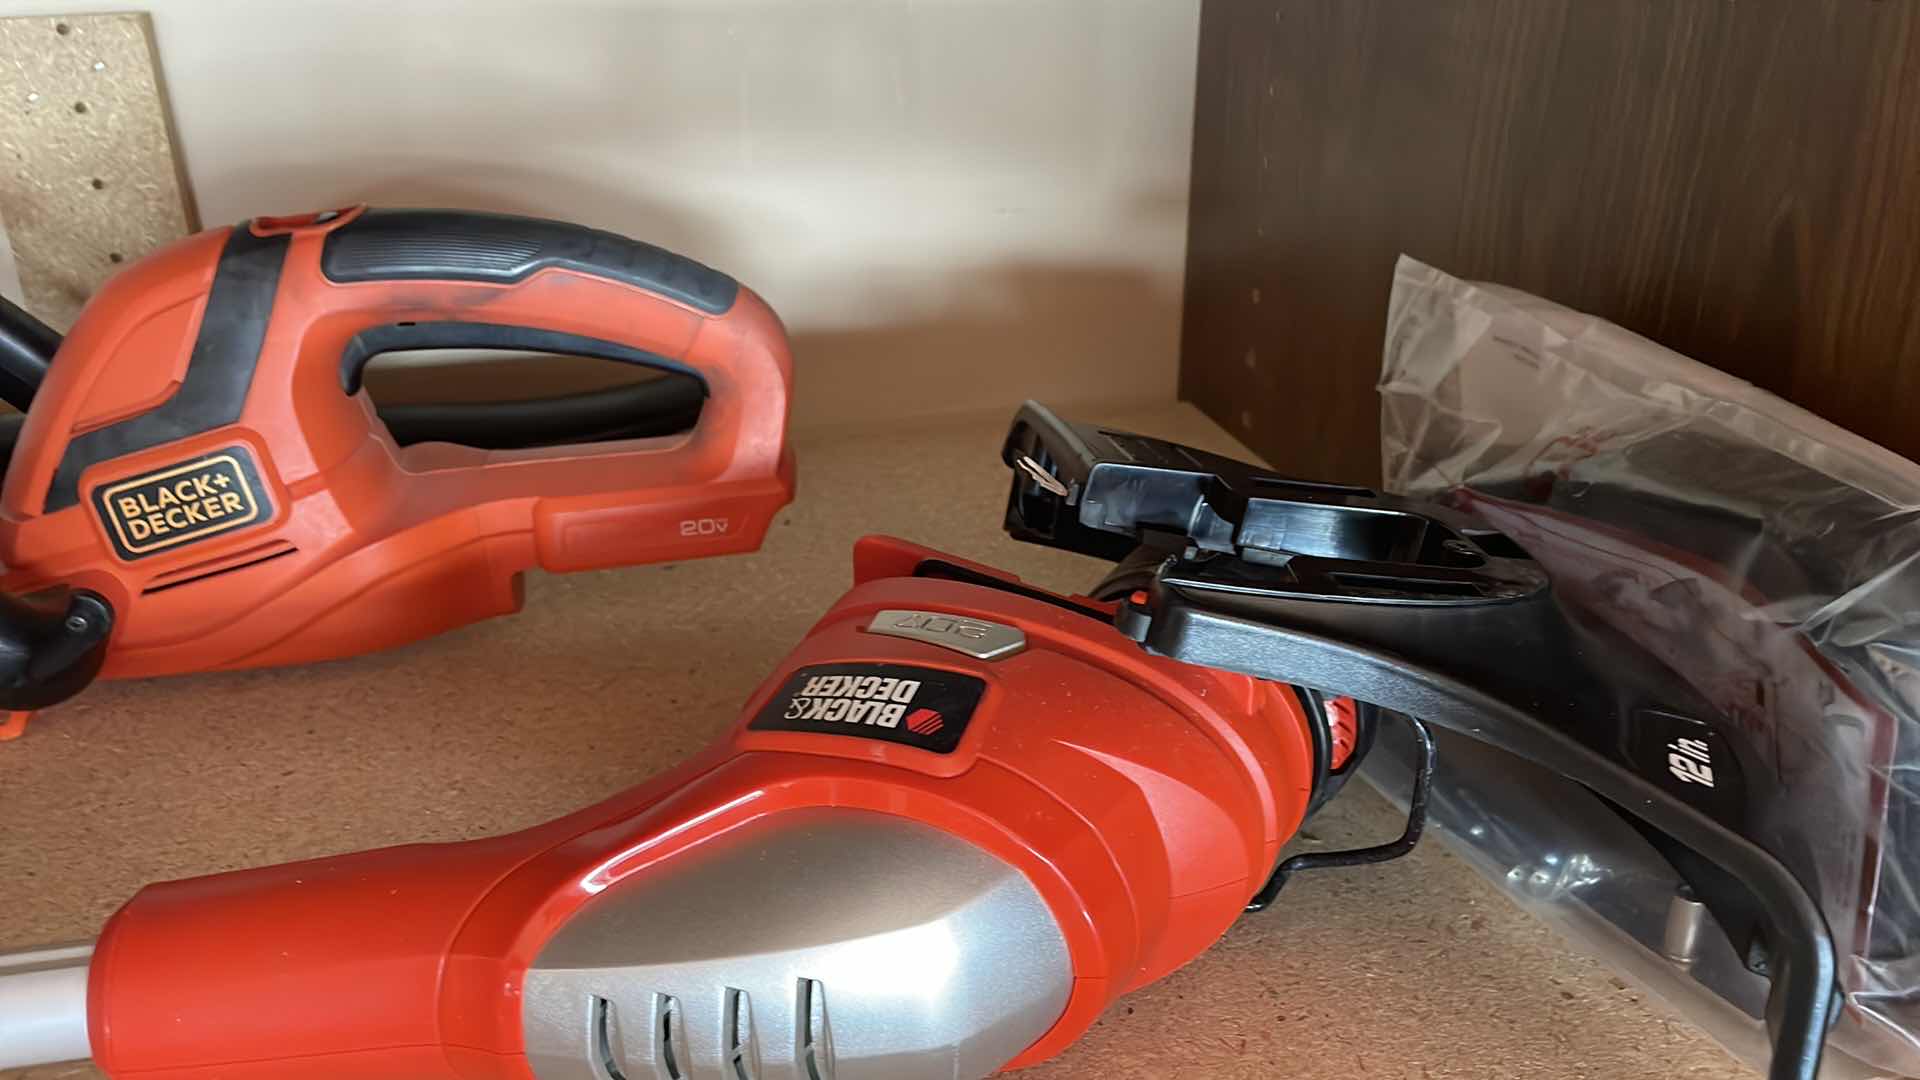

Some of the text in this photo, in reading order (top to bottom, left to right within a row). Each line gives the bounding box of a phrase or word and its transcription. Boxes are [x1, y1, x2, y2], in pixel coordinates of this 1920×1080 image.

[118, 474, 230, 519] BLACK+
[128, 492, 244, 540] DECKER
[802, 675, 921, 704] DECKER
